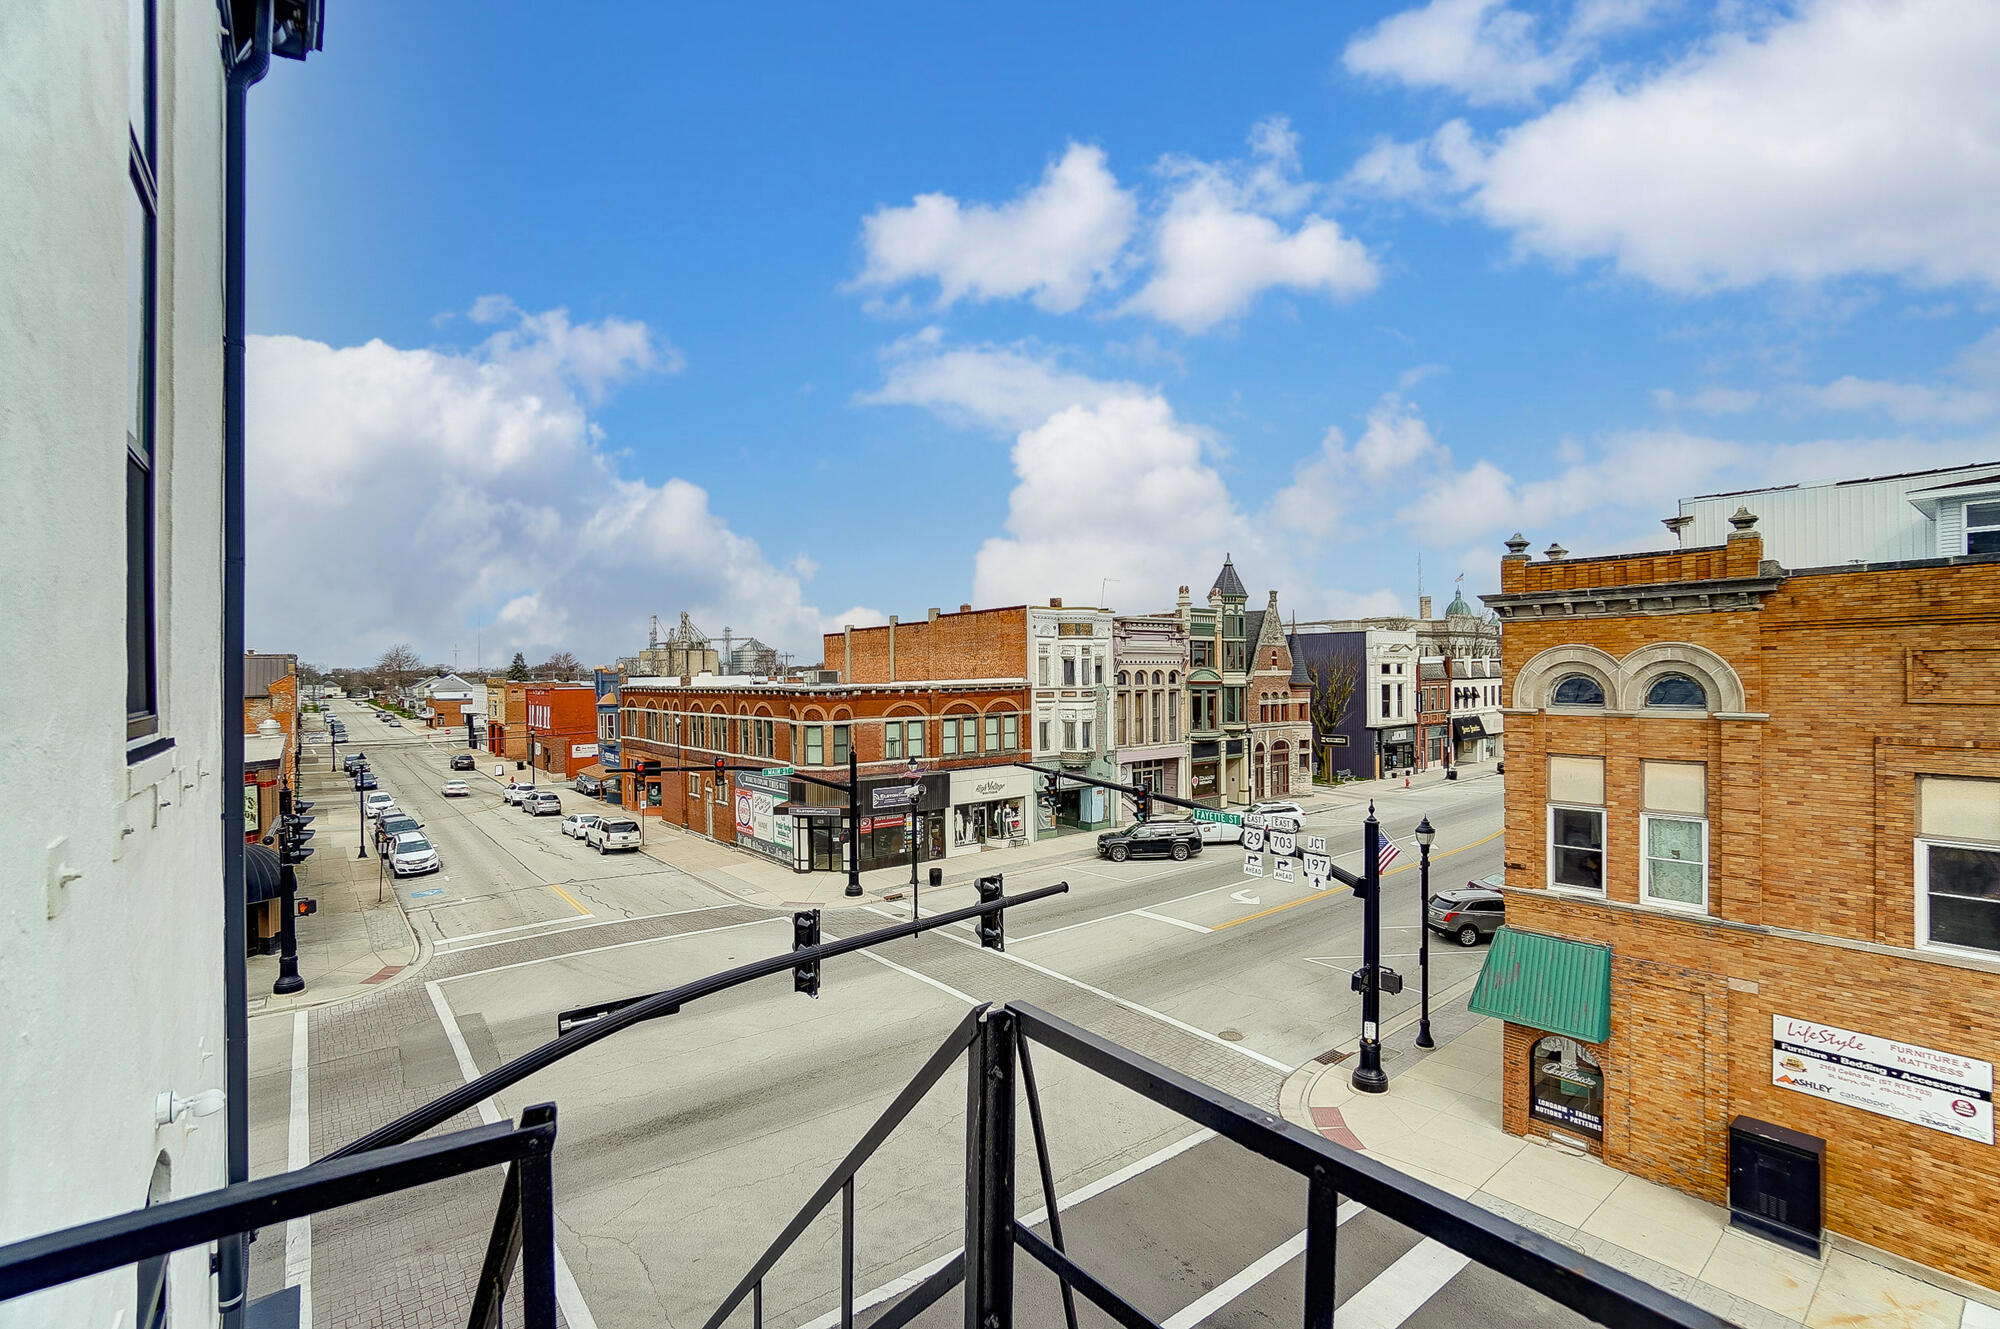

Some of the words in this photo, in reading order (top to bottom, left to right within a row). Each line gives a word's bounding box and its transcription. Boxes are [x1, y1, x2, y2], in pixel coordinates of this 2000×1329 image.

[1196, 809, 1228, 823] FAYETTE
[1229, 815, 1239, 824] ST
[1246, 814, 1261, 823] EAST
[1274, 818, 1291, 829] EAST
[1246, 831, 1261, 846] 29
[1273, 835, 1292, 849] 703
[1308, 837, 1325, 850] JCT
[1245, 865, 1262, 875] AHEAD
[1306, 858, 1327, 872] 197
[1274, 870, 1293, 881] AHEAD
[1889, 1044, 1960, 1066] FURNITURE
[1962, 1061, 1972, 1070] &
[1781, 1042, 1828, 1060] Furniture
[1840, 1056, 1888, 1077] Bedding
[1900, 1072, 1981, 1099] Accessories
[1896, 1055, 1965, 1078] MATTRESS
[1792, 1078, 1833, 1094] ASHLEY
[1535, 1104, 1563, 1119] NOTIONS
[1569, 1115, 1602, 1131] PATTERNS
[1575, 1110, 1600, 1123] FABRIC
